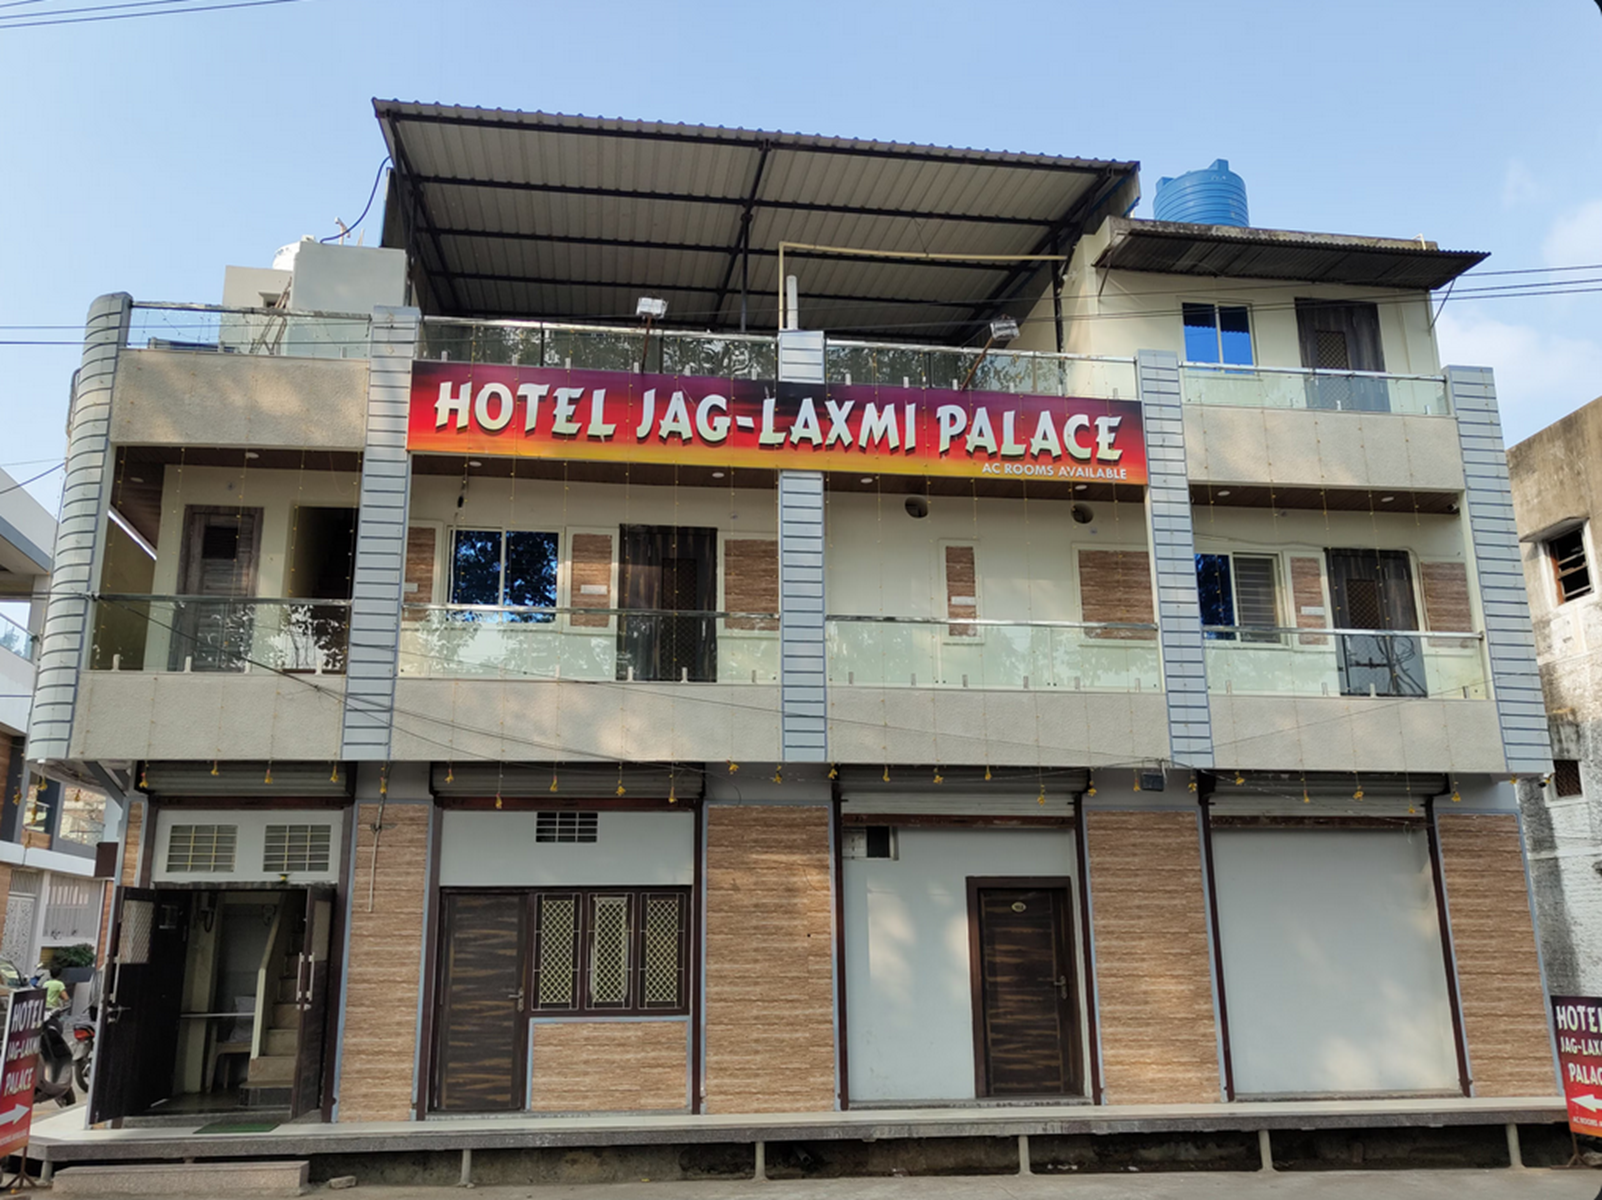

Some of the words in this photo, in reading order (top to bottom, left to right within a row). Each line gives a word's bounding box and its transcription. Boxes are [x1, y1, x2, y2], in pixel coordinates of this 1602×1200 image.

[434, 381, 616, 437] HOTEL
[636, 388, 916, 452] JAG-LAXMI
[936, 404, 1123, 461] PALACE
[982, 463, 1000, 474] AC
[1004, 463, 1054, 477] ROOMS
[1058, 466, 1127, 480] AVAILABLE
[11, 999, 44, 1033] HOTEL
[1560, 1036, 1602, 1056] JAG-LAX
[3, 1067, 35, 1097] PALACE
